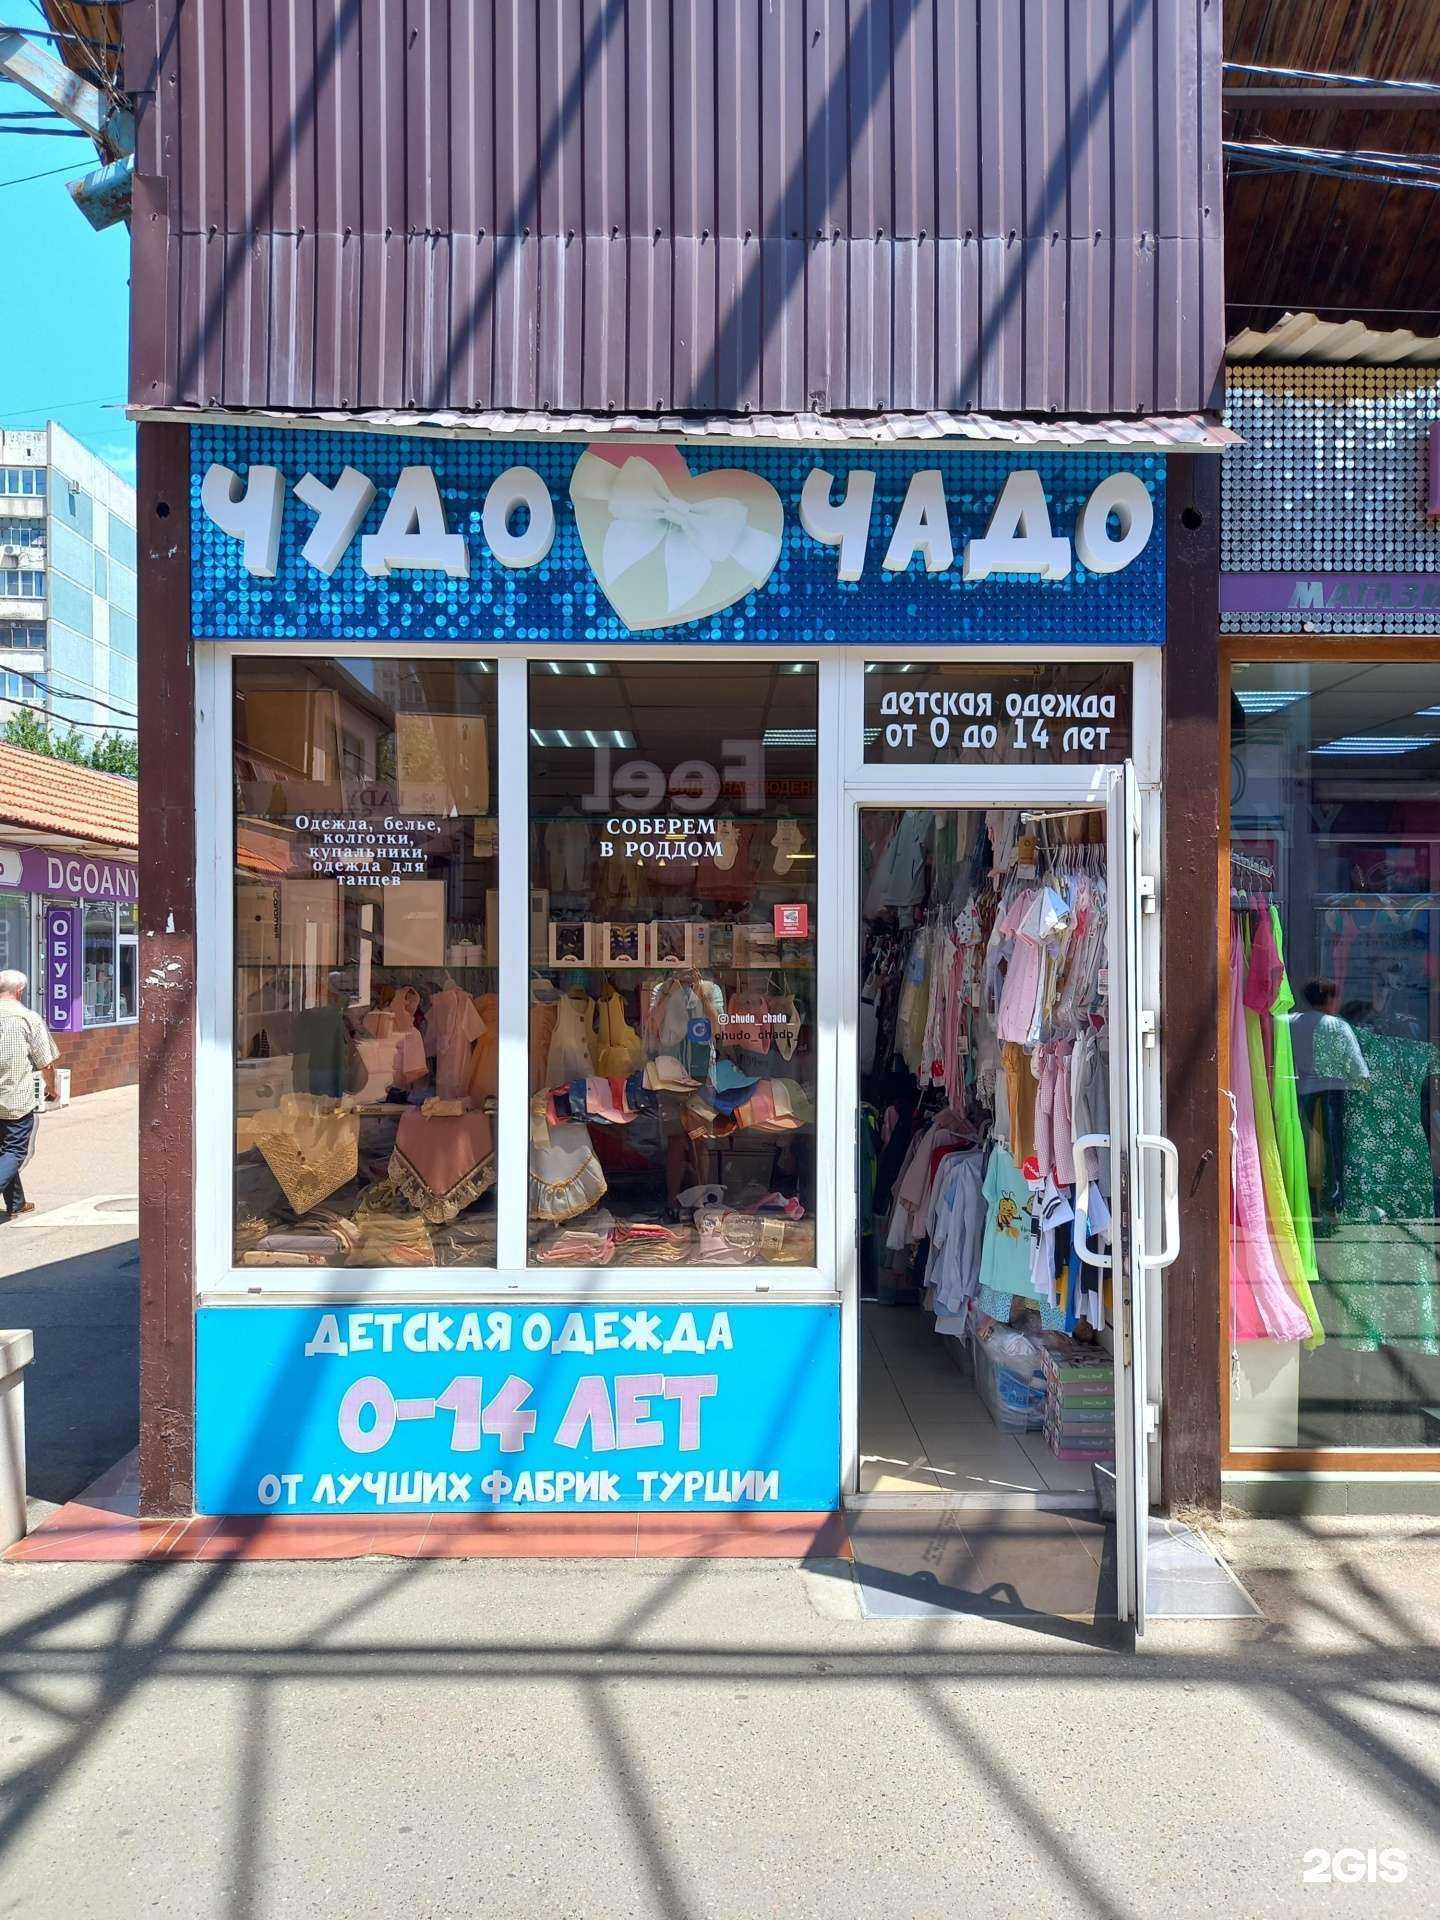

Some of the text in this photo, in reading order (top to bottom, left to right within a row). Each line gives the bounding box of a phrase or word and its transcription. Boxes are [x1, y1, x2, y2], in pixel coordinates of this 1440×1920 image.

[200, 463, 1154, 582] ЧУДО ЧАДО
[880, 691, 1116, 718] детская одежда
[885, 723, 917, 748] от
[961, 725, 998, 749] до
[1012, 718, 1049, 749] 14
[1062, 727, 1111, 752] лет
[295, 815, 441, 833] Одежда, белье,
[606, 818, 716, 835] СОБЕРЕМ
[323, 833, 415, 847] колготки,
[600, 841, 724, 859] В РОДДОМ
[309, 847, 429, 861] купальники,
[313, 860, 425, 872] одежда для
[336, 874, 401, 887] танцев
[52, 919, 69, 1022] ОБУВЬ
[304, 1311, 735, 1357] ДЕТСКАЯ ОДЕЖДА
[337, 1373, 719, 1454] 0-14 ЛЕТ
[257, 1469, 780, 1506] ОТ ЛУЧШИХ ФАБРИК ТУРЦИИ
